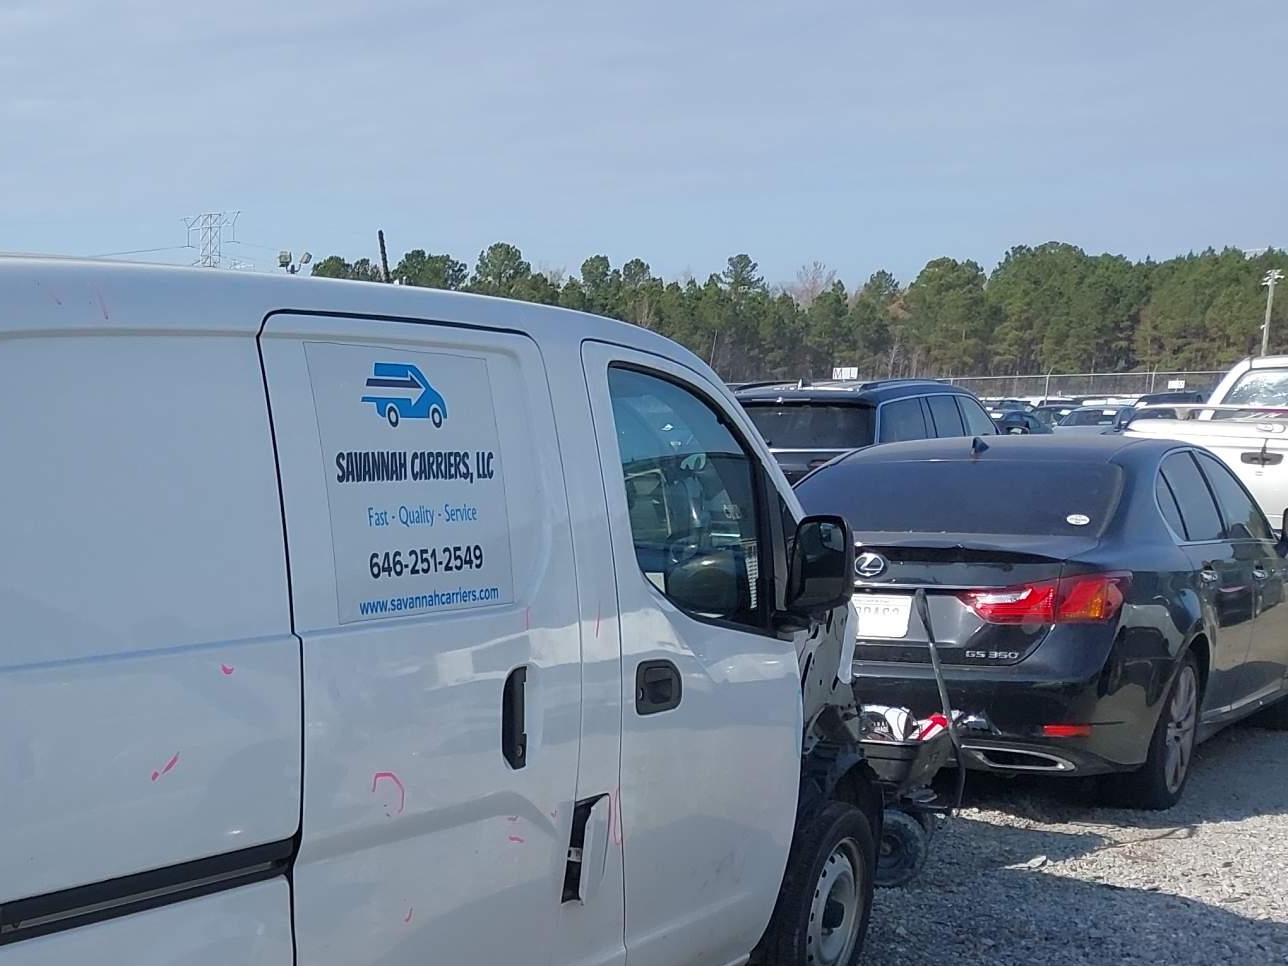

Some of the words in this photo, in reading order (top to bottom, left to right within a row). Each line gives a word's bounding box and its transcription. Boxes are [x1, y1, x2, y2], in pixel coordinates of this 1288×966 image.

[335, 451, 408, 483] SAVANNAH
[411, 451, 473, 484] CARRIERS,
[475, 451, 494, 480] LLC
[367, 506, 389, 528] Fast
[398, 505, 435, 529] Quality
[444, 503, 478, 523] Service
[369, 544, 484, 579] 646-251-2549
[359, 586, 500, 616] www.savannahcarriers.com
[965, 650, 987, 658] GS
[988, 651, 1020, 659] 350
